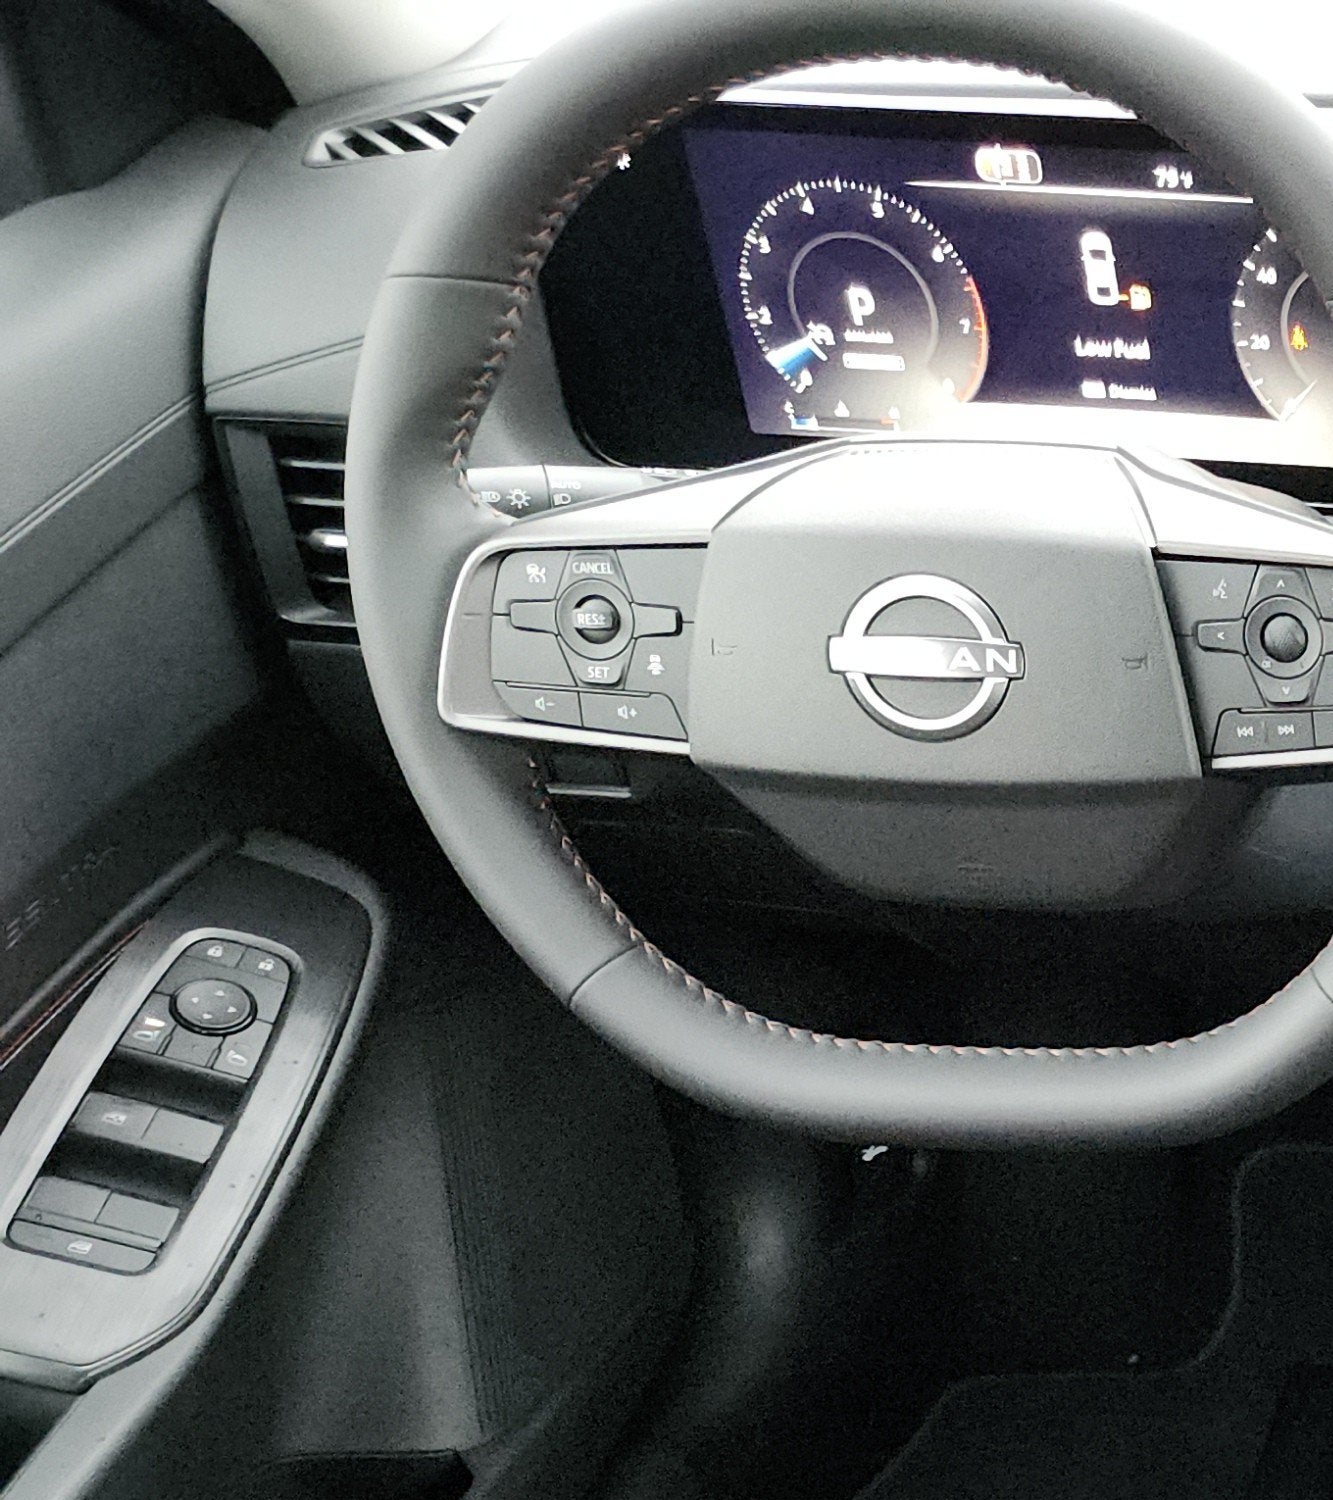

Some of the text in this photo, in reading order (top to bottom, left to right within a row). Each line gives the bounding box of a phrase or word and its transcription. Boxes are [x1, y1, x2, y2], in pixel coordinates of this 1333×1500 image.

[846, 282, 876, 326] P
[572, 562, 614, 575] CANCEL
[587, 667, 610, 679] SET
